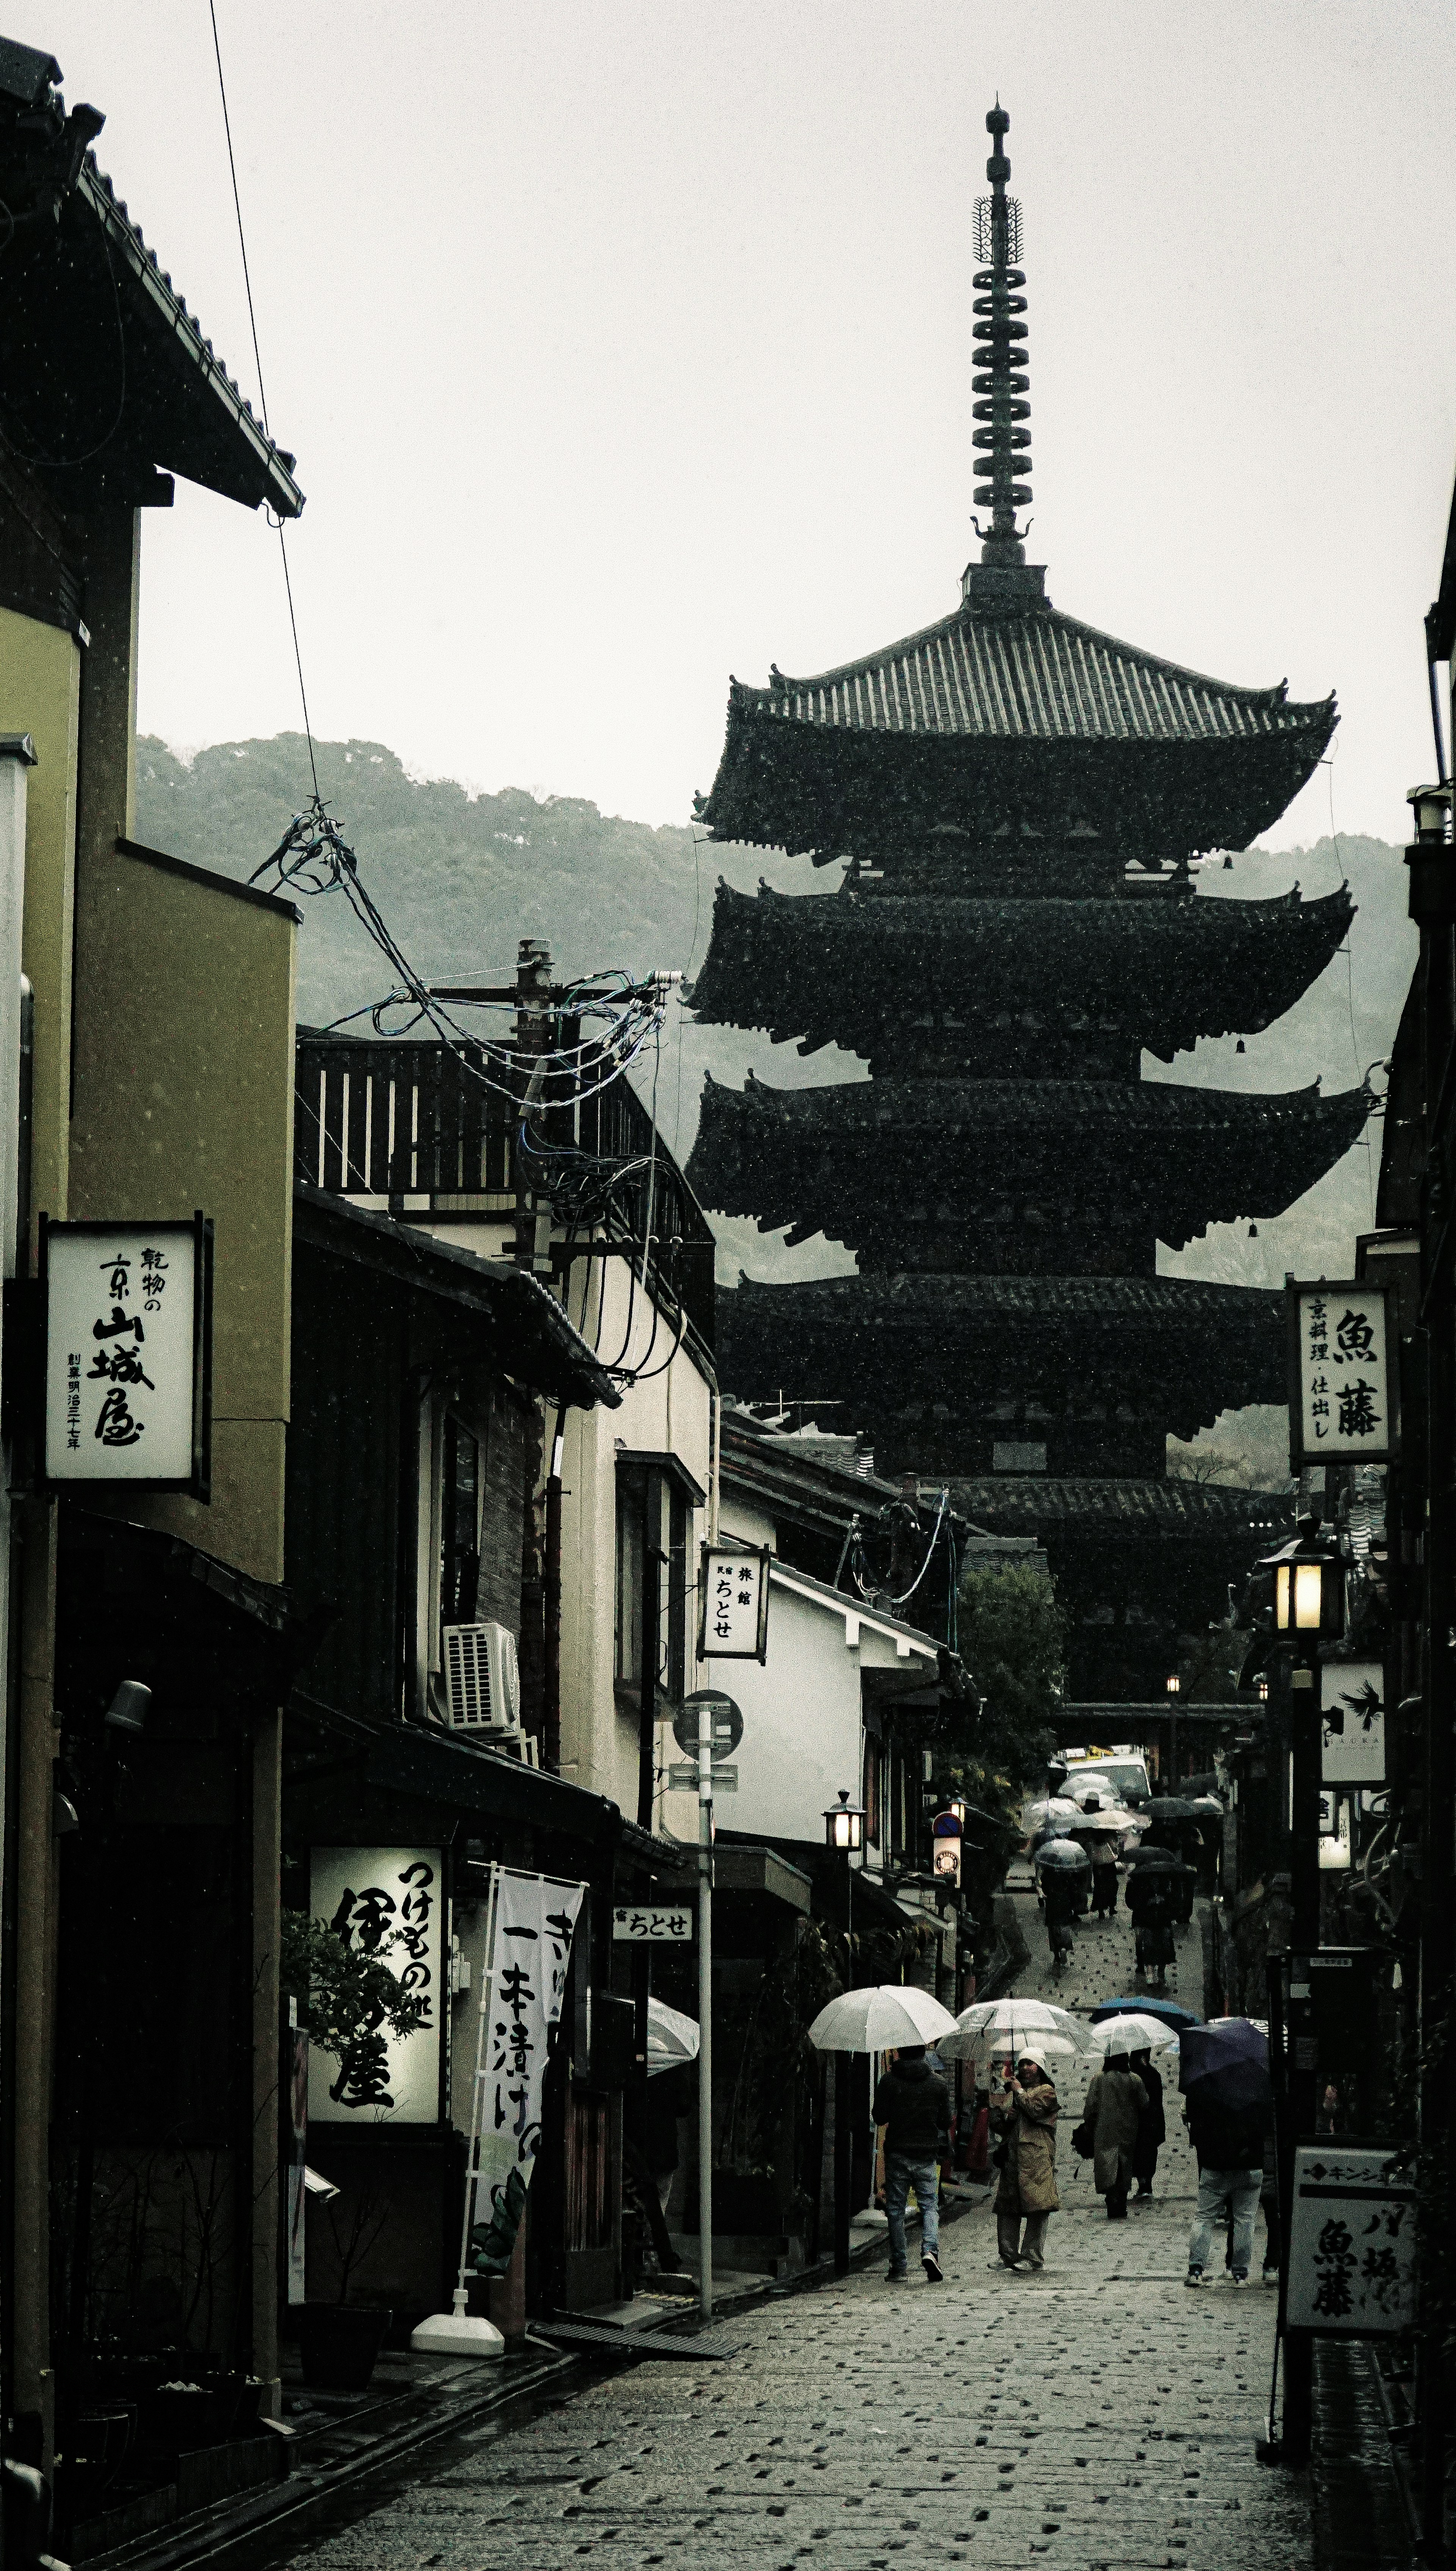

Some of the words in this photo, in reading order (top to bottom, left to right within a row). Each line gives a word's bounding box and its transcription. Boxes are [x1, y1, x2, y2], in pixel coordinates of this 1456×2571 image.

[141, 1248, 168, 1311] 乾物の
[67, 1353, 81, 1451] 創業明治三十七年
[1333, 1309, 1382, 1437] 魚藤
[713, 1580, 732, 1638] ちとせ
[737, 1567, 754, 1605] 旅館
[629, 1914, 687, 1936] ちとせ
[492, 1927, 538, 2137] 一本漬け
[1312, 2218, 1358, 2318] 魚藤
